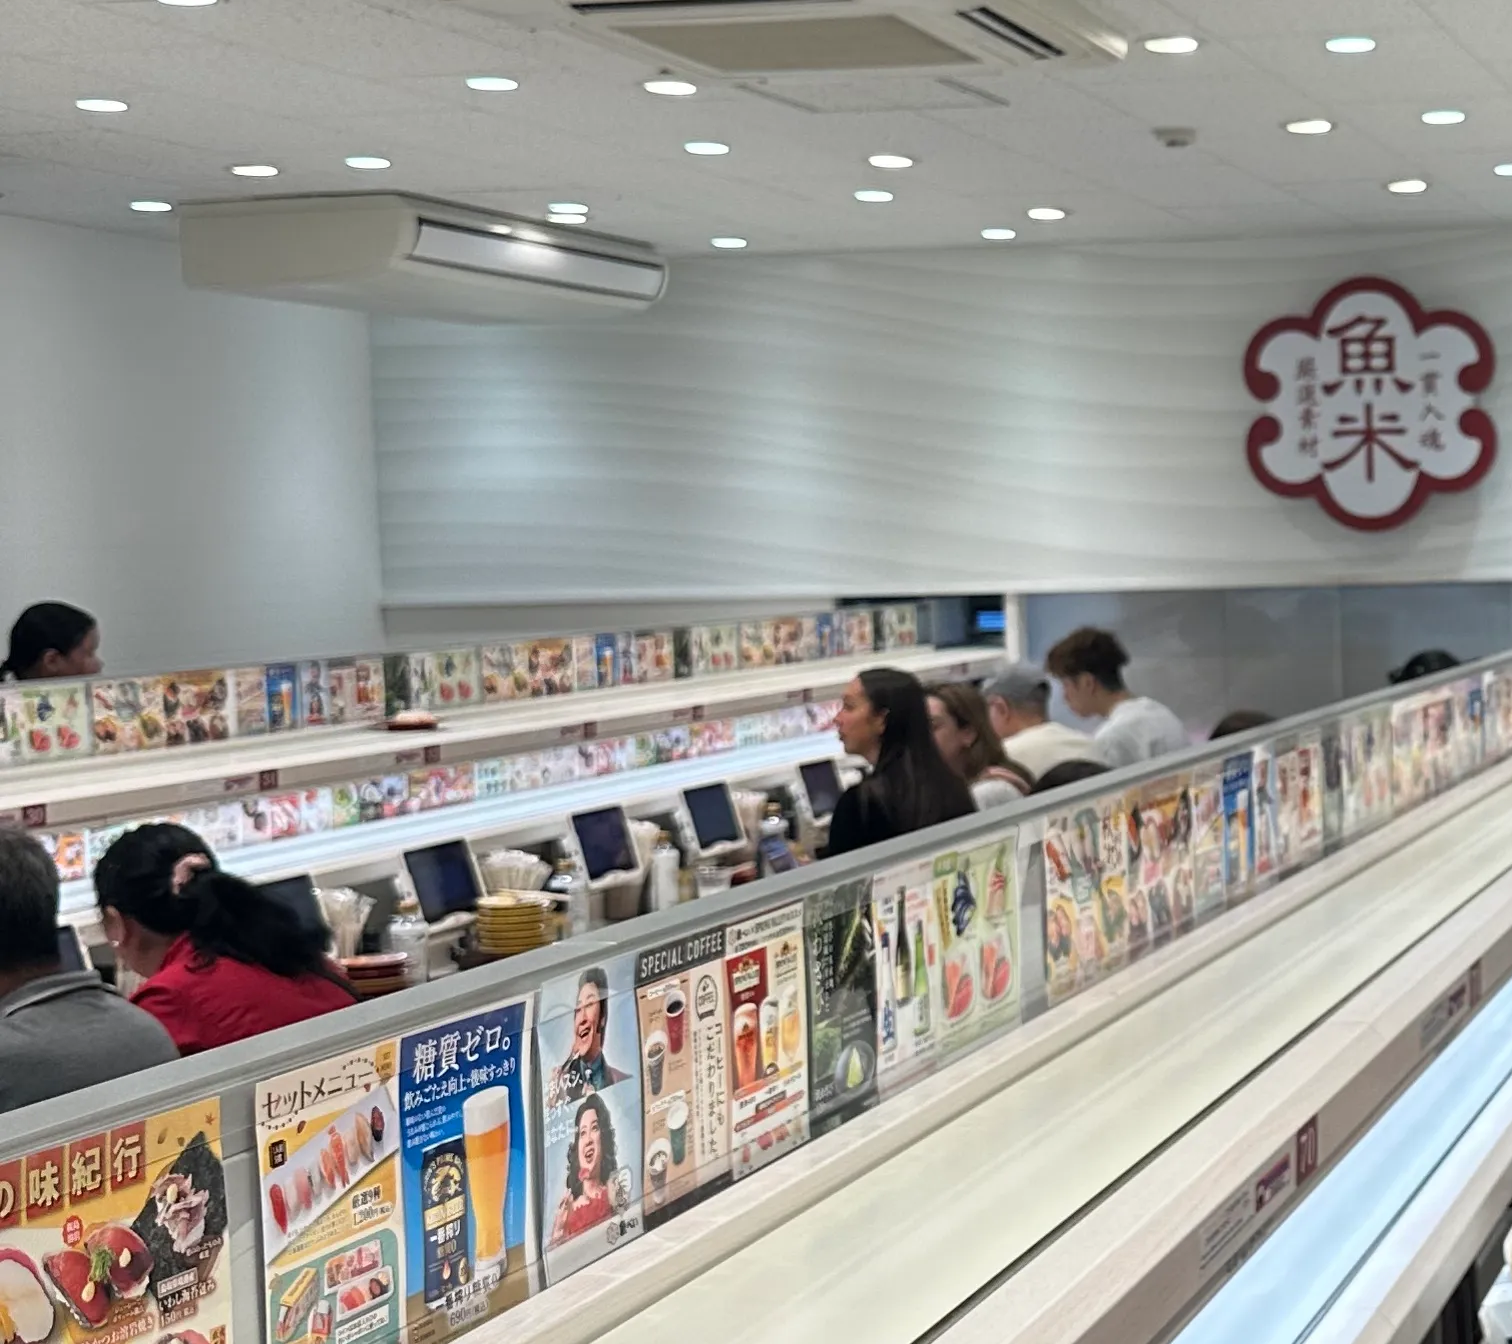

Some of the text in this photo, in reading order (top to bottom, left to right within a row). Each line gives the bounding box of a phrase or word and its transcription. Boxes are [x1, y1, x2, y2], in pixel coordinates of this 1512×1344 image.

[1320, 315, 1421, 484] 魚米
[640, 933, 723, 979] SPECIAL COFFEE
[412, 1025, 511, 1084] 糖質ゼロ。
[262, 1070, 374, 1119] セットメニュー
[1300, 1126, 1315, 1174] 70
